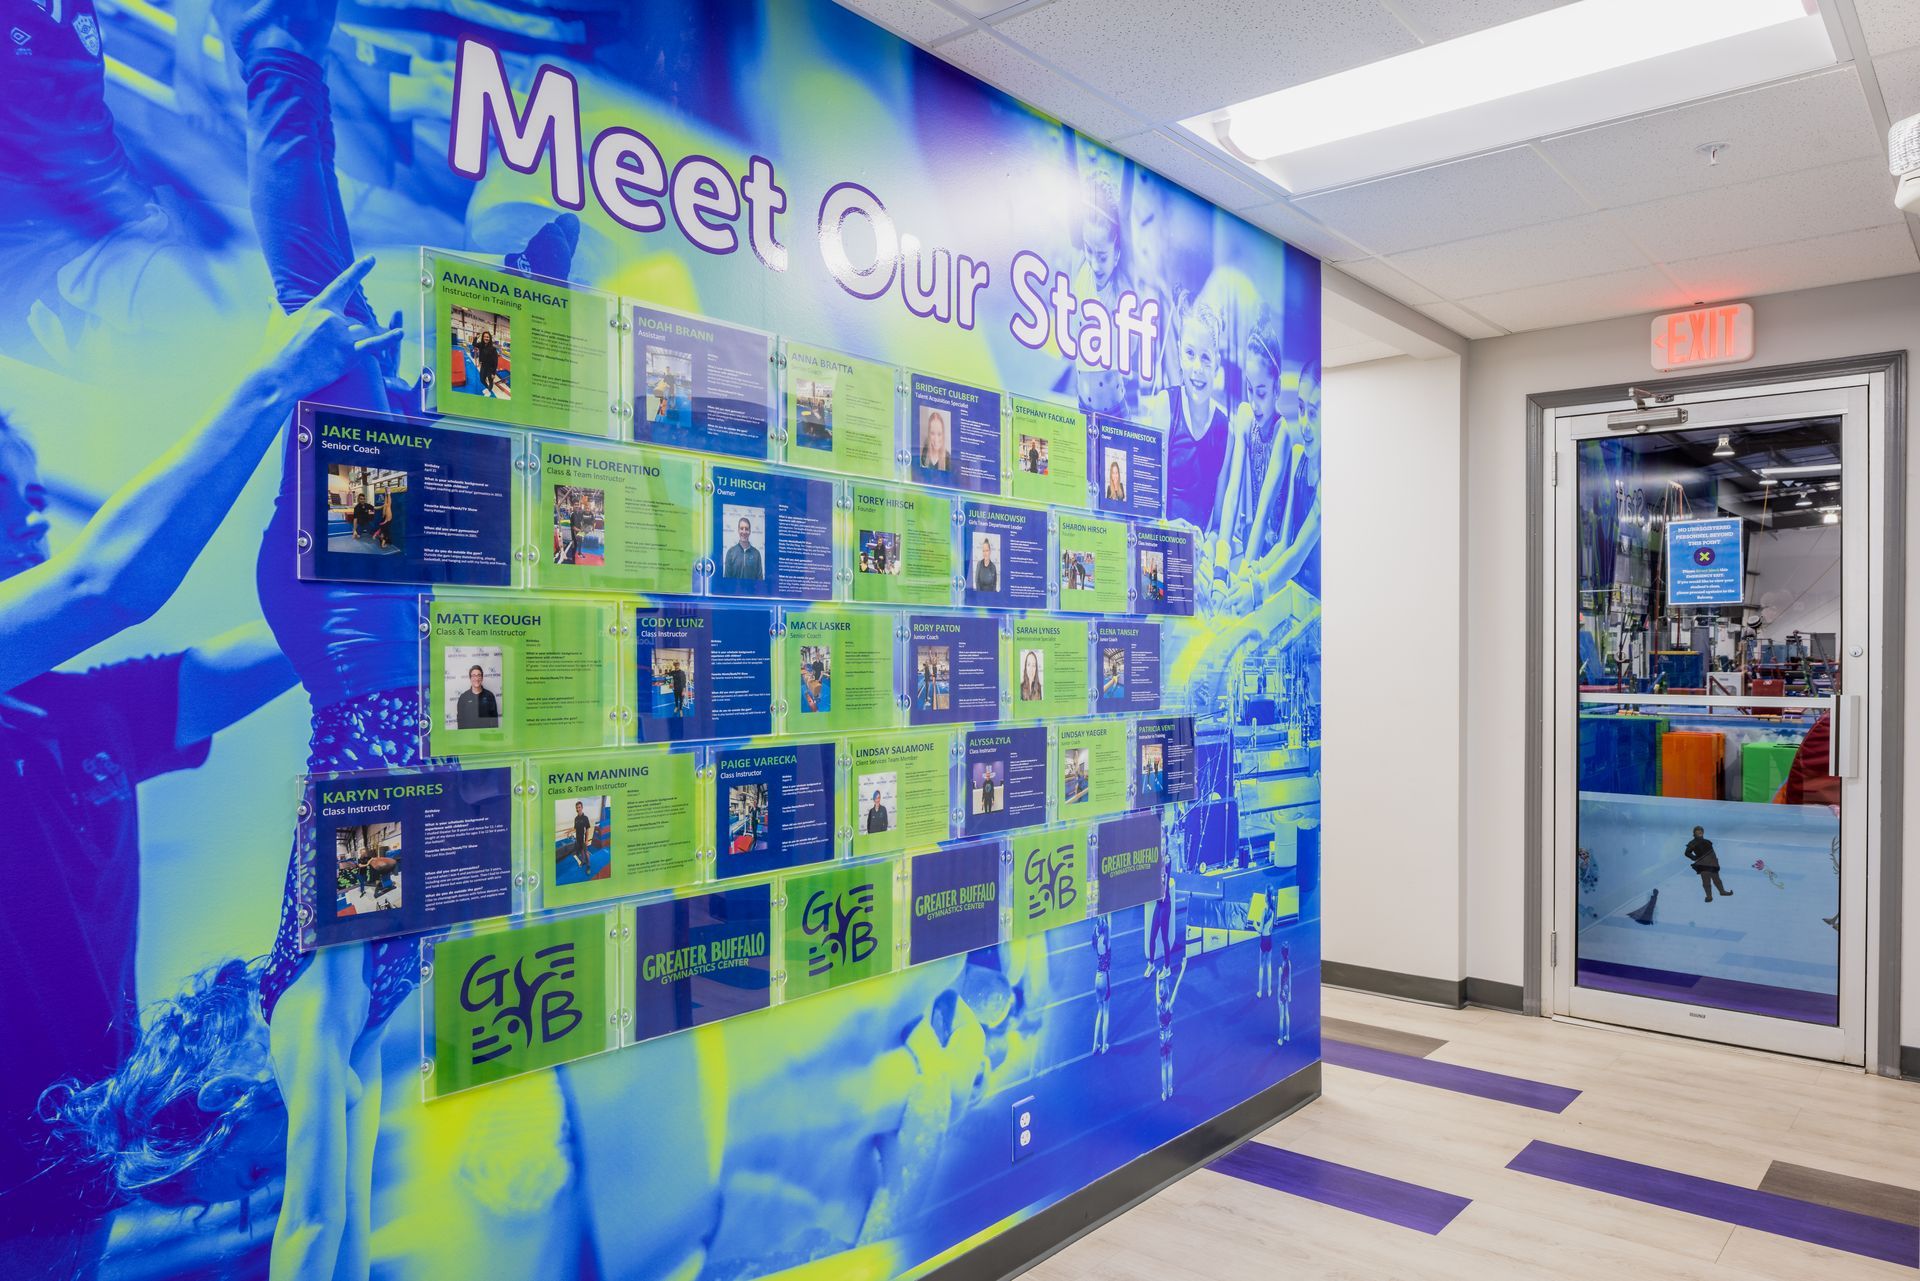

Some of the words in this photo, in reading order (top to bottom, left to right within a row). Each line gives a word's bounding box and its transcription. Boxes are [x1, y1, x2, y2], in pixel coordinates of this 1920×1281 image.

[449, 33, 788, 272] Meet
[817, 181, 989, 331] Our
[1009, 250, 1160, 382] Staff
[442, 286, 481, 301] Instructor
[482, 294, 490, 302] in
[492, 297, 522, 310] Training
[443, 271, 509, 296] AMANDA
[514, 287, 568, 309] BAHGAT
[638, 317, 672, 333] NOAH
[676, 325, 714, 342] BRANN
[638, 330, 666, 341] Assistant
[1668, 307, 1738, 364] EXIT
[792, 353, 818, 366] ANNA
[821, 360, 853, 374] BRATTA
[915, 382, 947, 396] BRIDGET
[948, 389, 979, 403] CULBERT
[915, 392, 929, 402] Talent
[929, 395, 950, 406] Acquisition
[950, 398, 969, 408] Specialist
[1016, 405, 1047, 419] STEPHANY
[1048, 413, 1076, 426] FACKLAM
[321, 424, 361, 441] JAKE
[366, 432, 432, 450] HAWLEY
[1102, 425, 1123, 436] KRISTEN
[1123, 430, 1156, 444] FAHNESTOCK
[321, 440, 351, 451] Senior
[353, 444, 380, 455] Coach
[546, 454, 582, 467] JOHN
[586, 458, 660, 478] FLORENTINO
[547, 467, 564, 476] Class
[573, 470, 592, 479] Team
[593, 472, 625, 483] Instructor
[717, 476, 727, 486] TJ
[730, 479, 766, 491] HIRSCH
[858, 495, 884, 506] TOREY
[886, 499, 914, 510] HIRSCH
[968, 509, 987, 519] JULIE
[987, 512, 1026, 524] JANKOWSKI
[1062, 522, 1087, 532] SHARON
[1087, 526, 1107, 535] HIRSCH
[1138, 532, 1159, 541] CAMILLE
[437, 613, 479, 625] MATT
[483, 614, 541, 626] KEOUGH
[641, 617, 673, 628] CODY
[676, 618, 704, 628] LUNZ
[790, 621, 818, 631] MACK
[820, 622, 850, 631] LASKER
[436, 628, 456, 636] Class
[458, 628, 465, 636] &
[466, 629, 488, 637] Team
[490, 629, 527, 637] Instructor
[914, 623, 933, 632] RORY
[935, 624, 961, 633] PATON
[1017, 626, 1038, 634] SARAH
[1038, 627, 1060, 635] LYNESS
[1100, 628, 1117, 636] ELENA
[970, 737, 994, 747] ALYSSA
[995, 736, 1011, 746] ZYLA
[1062, 730, 1085, 739] LINDSAY
[1086, 728, 1107, 737] YAEGER
[856, 747, 890, 758] LINDSAY
[891, 743, 934, 756] SALAMONE
[721, 758, 751, 770] PAIGE
[753, 754, 797, 767] VARECKA
[855, 759, 869, 767] Client
[900, 755, 918, 763] Member
[548, 772, 583, 785] RYAN
[587, 766, 649, 781] MANNING
[720, 771, 735, 779] Class
[735, 770, 762, 778] Instructor
[323, 788, 379, 805] KARYN
[384, 783, 443, 800] TORRES
[548, 786, 566, 795] Class
[567, 786, 573, 794] &
[575, 785, 594, 793] Team
[595, 782, 627, 791] Instructor
[323, 807, 346, 817] Class
[348, 803, 391, 814] Instructor
[1102, 853, 1131, 874] GREATER
[1133, 846, 1159, 865] BUFFALO
[1109, 864, 1136, 879] GYMNASTICS
[1136, 863, 1151, 873] CENTER
[916, 889, 957, 917] GREATER
[959, 881, 996, 904] BUFFALO
[927, 904, 963, 921] GYMNASTICS
[963, 902, 985, 912] CENTER
[642, 945, 707, 982] GREATER
[710, 931, 765, 964] BUFFALO
[660, 961, 715, 985] GYMNASTICS
[718, 957, 749, 971] CENTER
